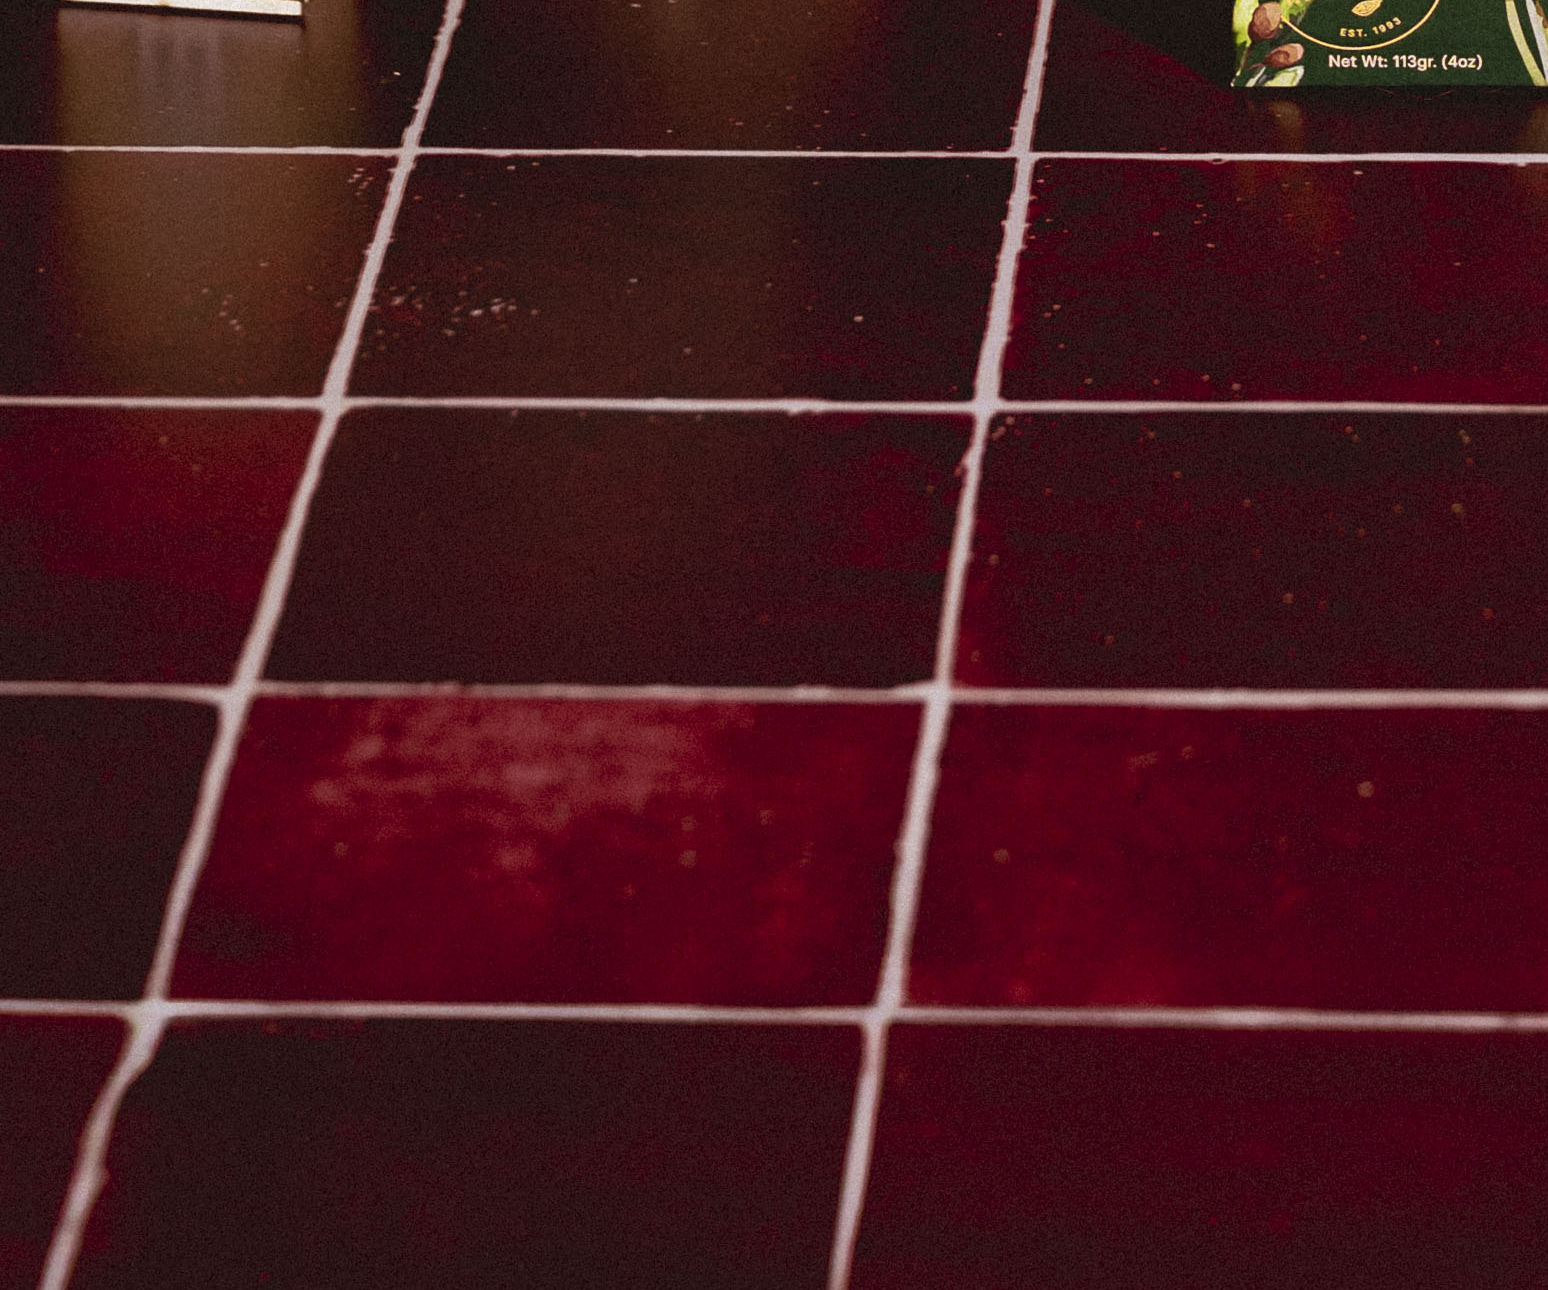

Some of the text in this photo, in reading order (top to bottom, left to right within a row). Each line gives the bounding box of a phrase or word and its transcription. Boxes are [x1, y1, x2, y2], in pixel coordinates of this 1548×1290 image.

[1339, 27, 1368, 38] EST.
[1328, 53, 1483, 71] Net Wt: 113gr. (4oz)
